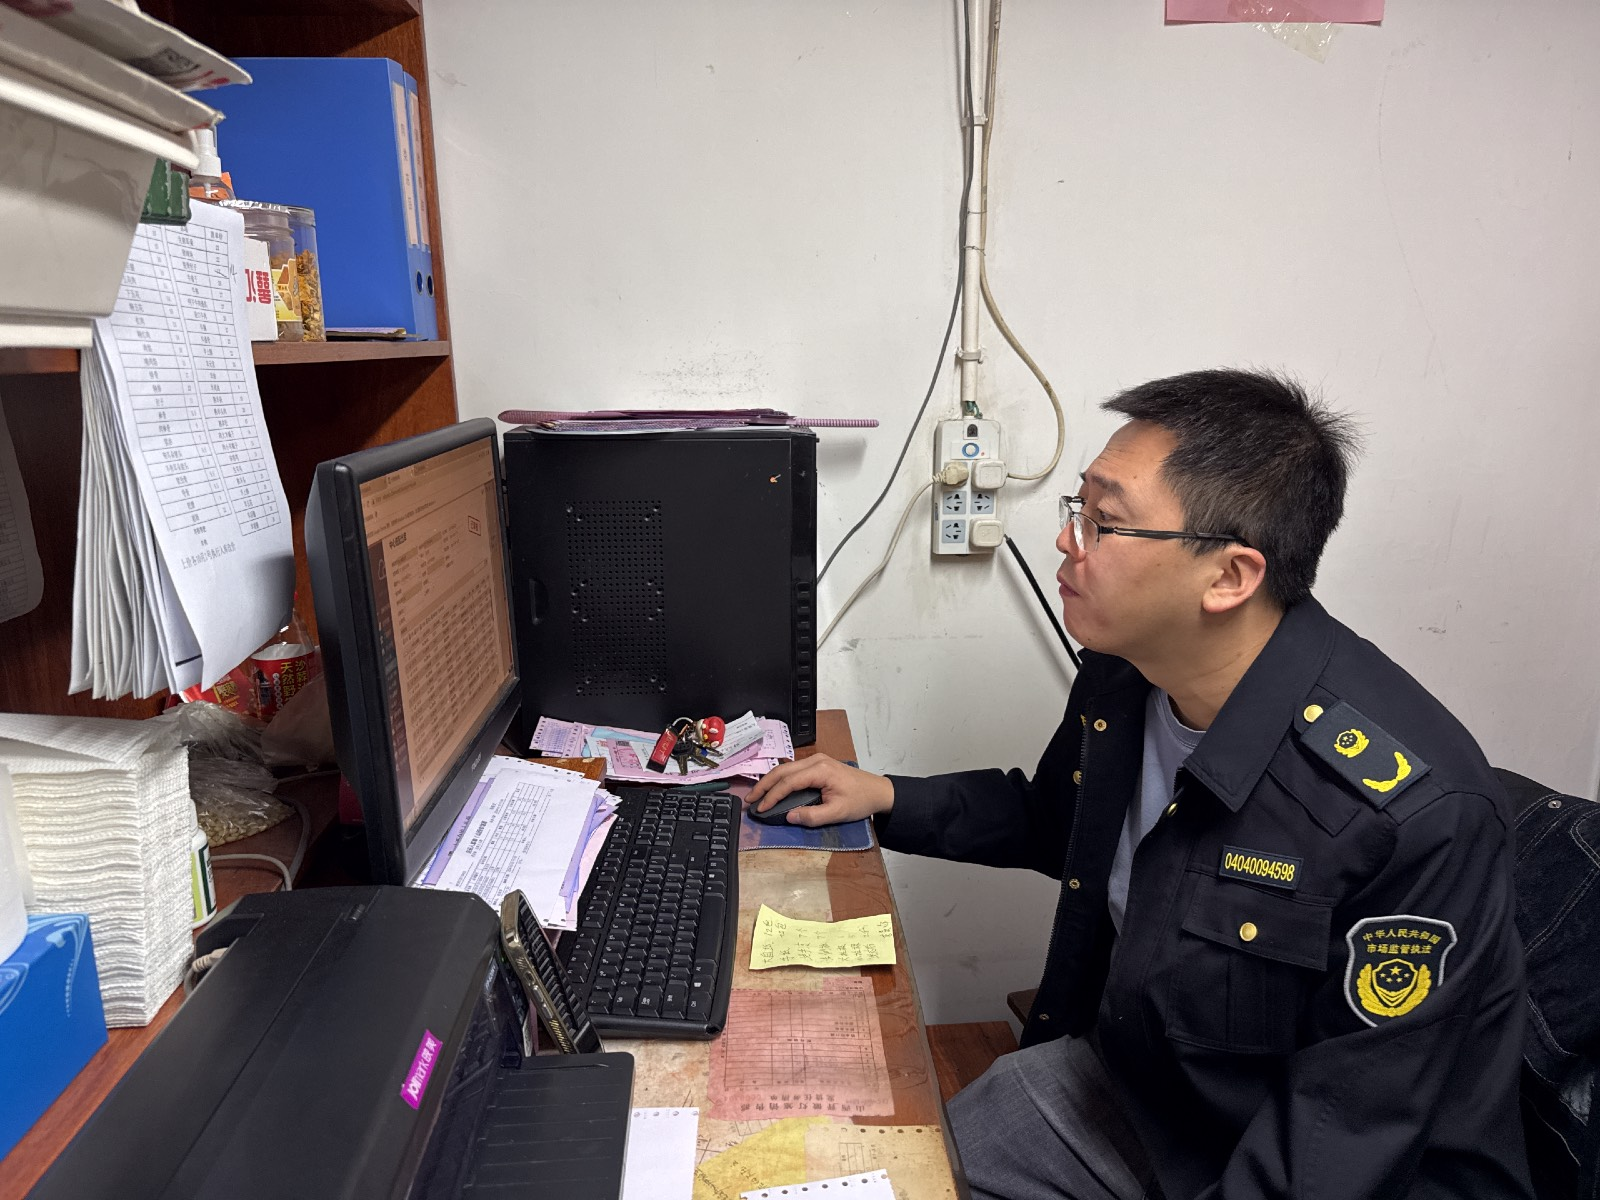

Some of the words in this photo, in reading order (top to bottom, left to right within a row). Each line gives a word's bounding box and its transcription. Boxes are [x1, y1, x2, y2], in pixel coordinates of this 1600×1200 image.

[280, 662, 295, 701] 天然野
[1224, 852, 1295, 882] 04040094598
[1362, 928, 1442, 945] 中华人民共和国
[1366, 943, 1432, 954] 市场监管执法
